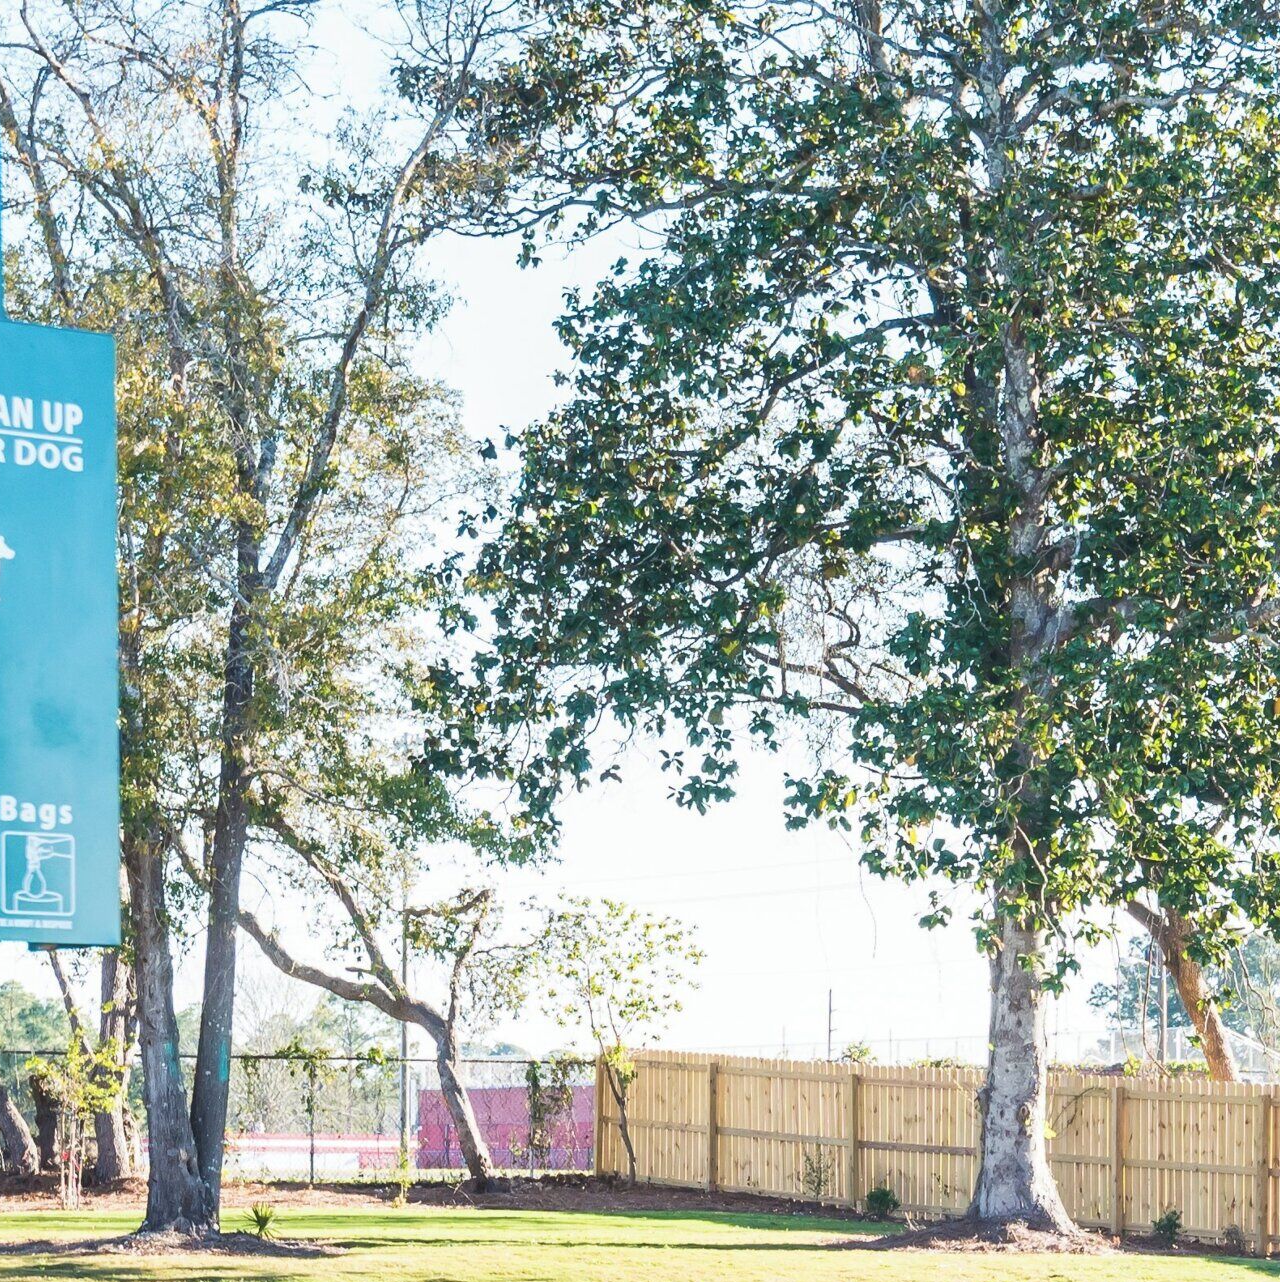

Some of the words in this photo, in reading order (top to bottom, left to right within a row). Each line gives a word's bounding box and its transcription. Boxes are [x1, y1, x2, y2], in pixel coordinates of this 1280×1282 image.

[41, 402, 84, 435] UP
[13, 440, 84, 472] DOG
[0, 795, 73, 830] Bags
